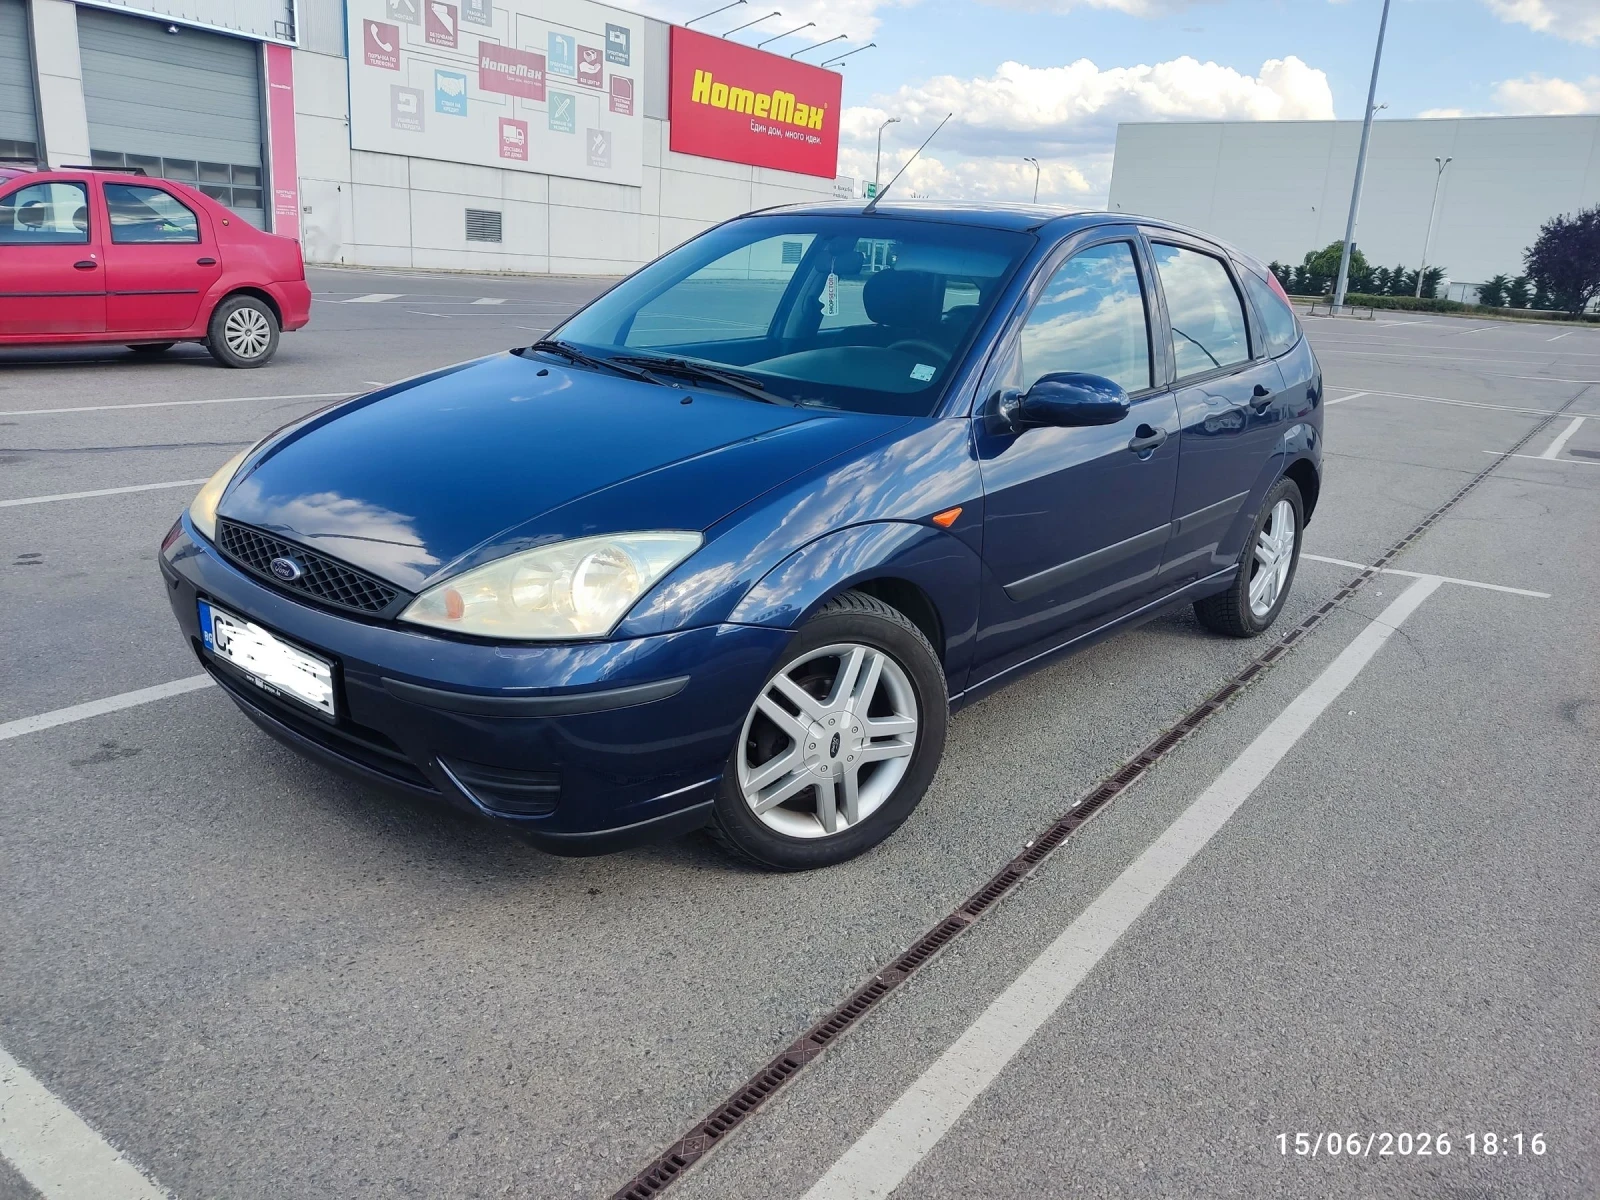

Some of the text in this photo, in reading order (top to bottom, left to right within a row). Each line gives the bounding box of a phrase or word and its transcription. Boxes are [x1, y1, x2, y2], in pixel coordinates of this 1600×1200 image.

[367, 52, 390, 62] ПОРЪЧКА
[370, 59, 395, 68] ТЕЛЕФОНА
[481, 56, 542, 80] HomeMax
[691, 69, 824, 130] HomeMax
[750, 119, 822, 145] Един дом, много идеи.
[204, 630, 213, 644] BG
